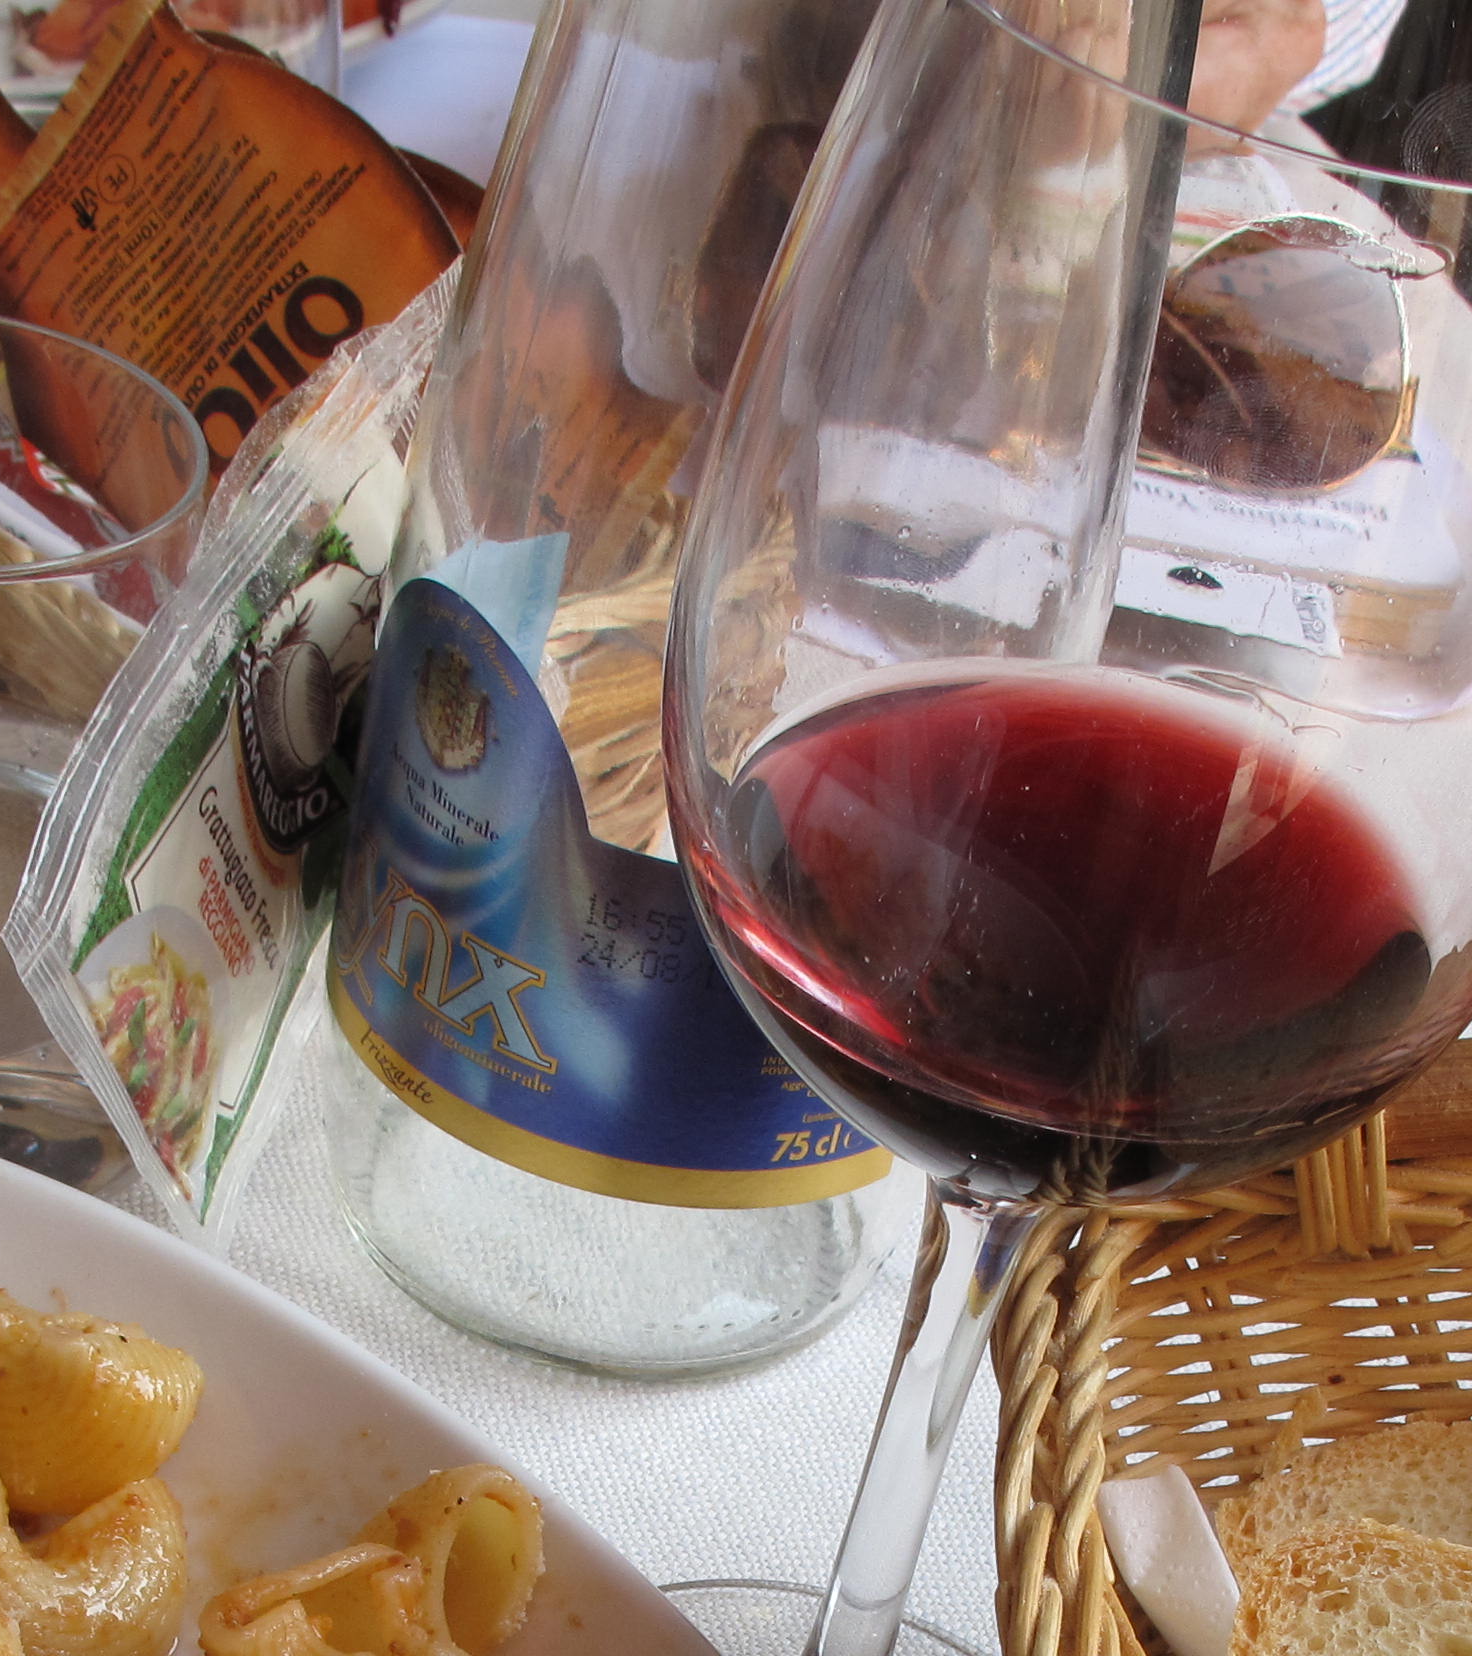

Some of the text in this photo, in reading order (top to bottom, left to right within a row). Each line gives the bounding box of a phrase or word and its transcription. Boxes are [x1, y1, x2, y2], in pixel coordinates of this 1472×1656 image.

[122, 217, 160, 259] 10ml
[218, 260, 309, 359] EXTRAVERGINE
[405, 784, 465, 850] Naturale
[429, 777, 501, 846] Minerale
[199, 786, 257, 914] Grattugiato
[360, 1027, 435, 1111] Frizzante
[770, 1130, 812, 1163] 75
[814, 1122, 843, 1157] cl
